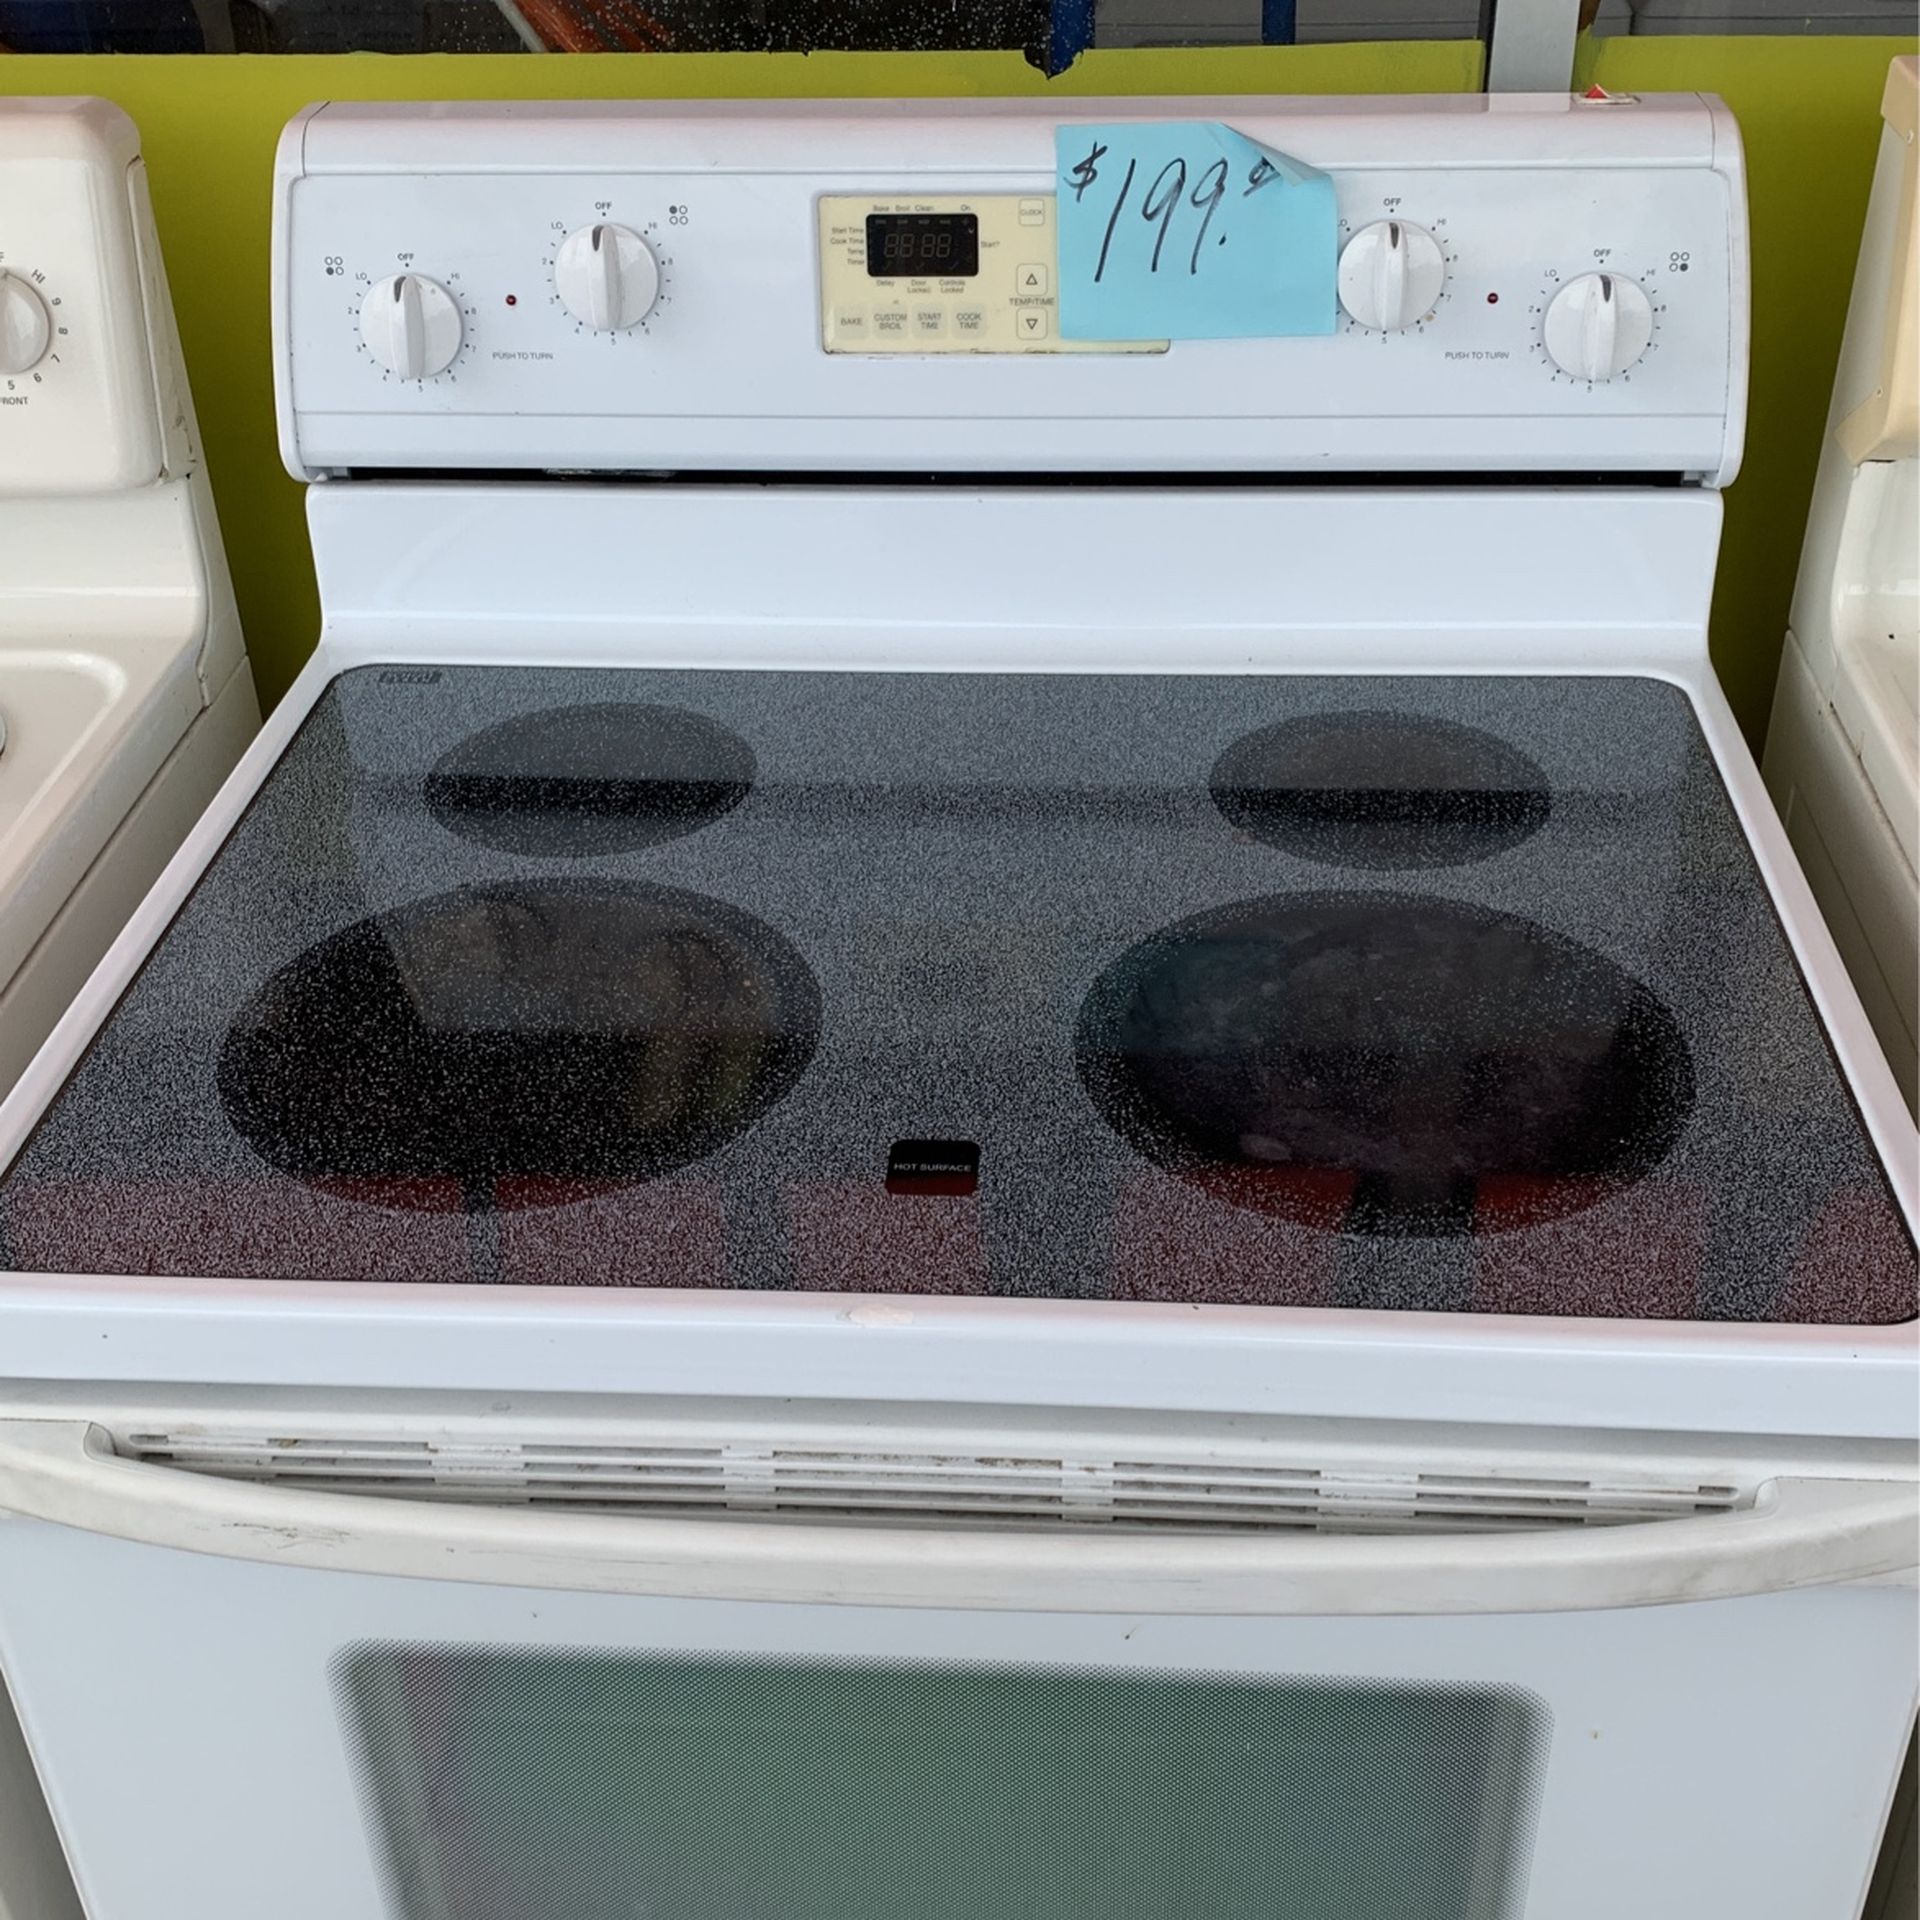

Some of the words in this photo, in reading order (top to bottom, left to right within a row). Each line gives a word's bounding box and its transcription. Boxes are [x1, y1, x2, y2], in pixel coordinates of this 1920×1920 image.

[594, 202, 613, 210] OFF
[1383, 198, 1402, 206] OFF
[551, 221, 564, 230] LO
[1437, 218, 1447, 226] HI
[848, 248, 864, 256] Temp
[1593, 249, 1612, 257] OFF
[397, 253, 415, 261] OFF
[31, 269, 46, 284] HI
[355, 272, 368, 281] LO
[1544, 269, 1558, 278] LO
[876, 279, 895, 287] Delay
[51, 297, 61, 306] 9
[874, 313, 907, 321] CUSTOM
[917, 313, 942, 321] START
[956, 313, 981, 321] COOK
[841, 317, 863, 326] BAKE
[879, 322, 902, 330] BROIL
[921, 322, 939, 330] TIME
[959, 322, 979, 330] TIME
[58, 327, 68, 335] 8
[51, 353, 60, 363] 7
[492, 352, 516, 360] PUSH
[517, 352, 529, 360] TO
[530, 352, 554, 360] TURN
[1445, 351, 1470, 360] PUSH
[1472, 351, 1484, 360] TO
[1485, 351, 1510, 360] TURN
[33, 373, 42, 382] 6
[7, 380, 15, 390] 5
[894, 1163, 917, 1171] HOT
[920, 1163, 972, 1172] SURFACE
